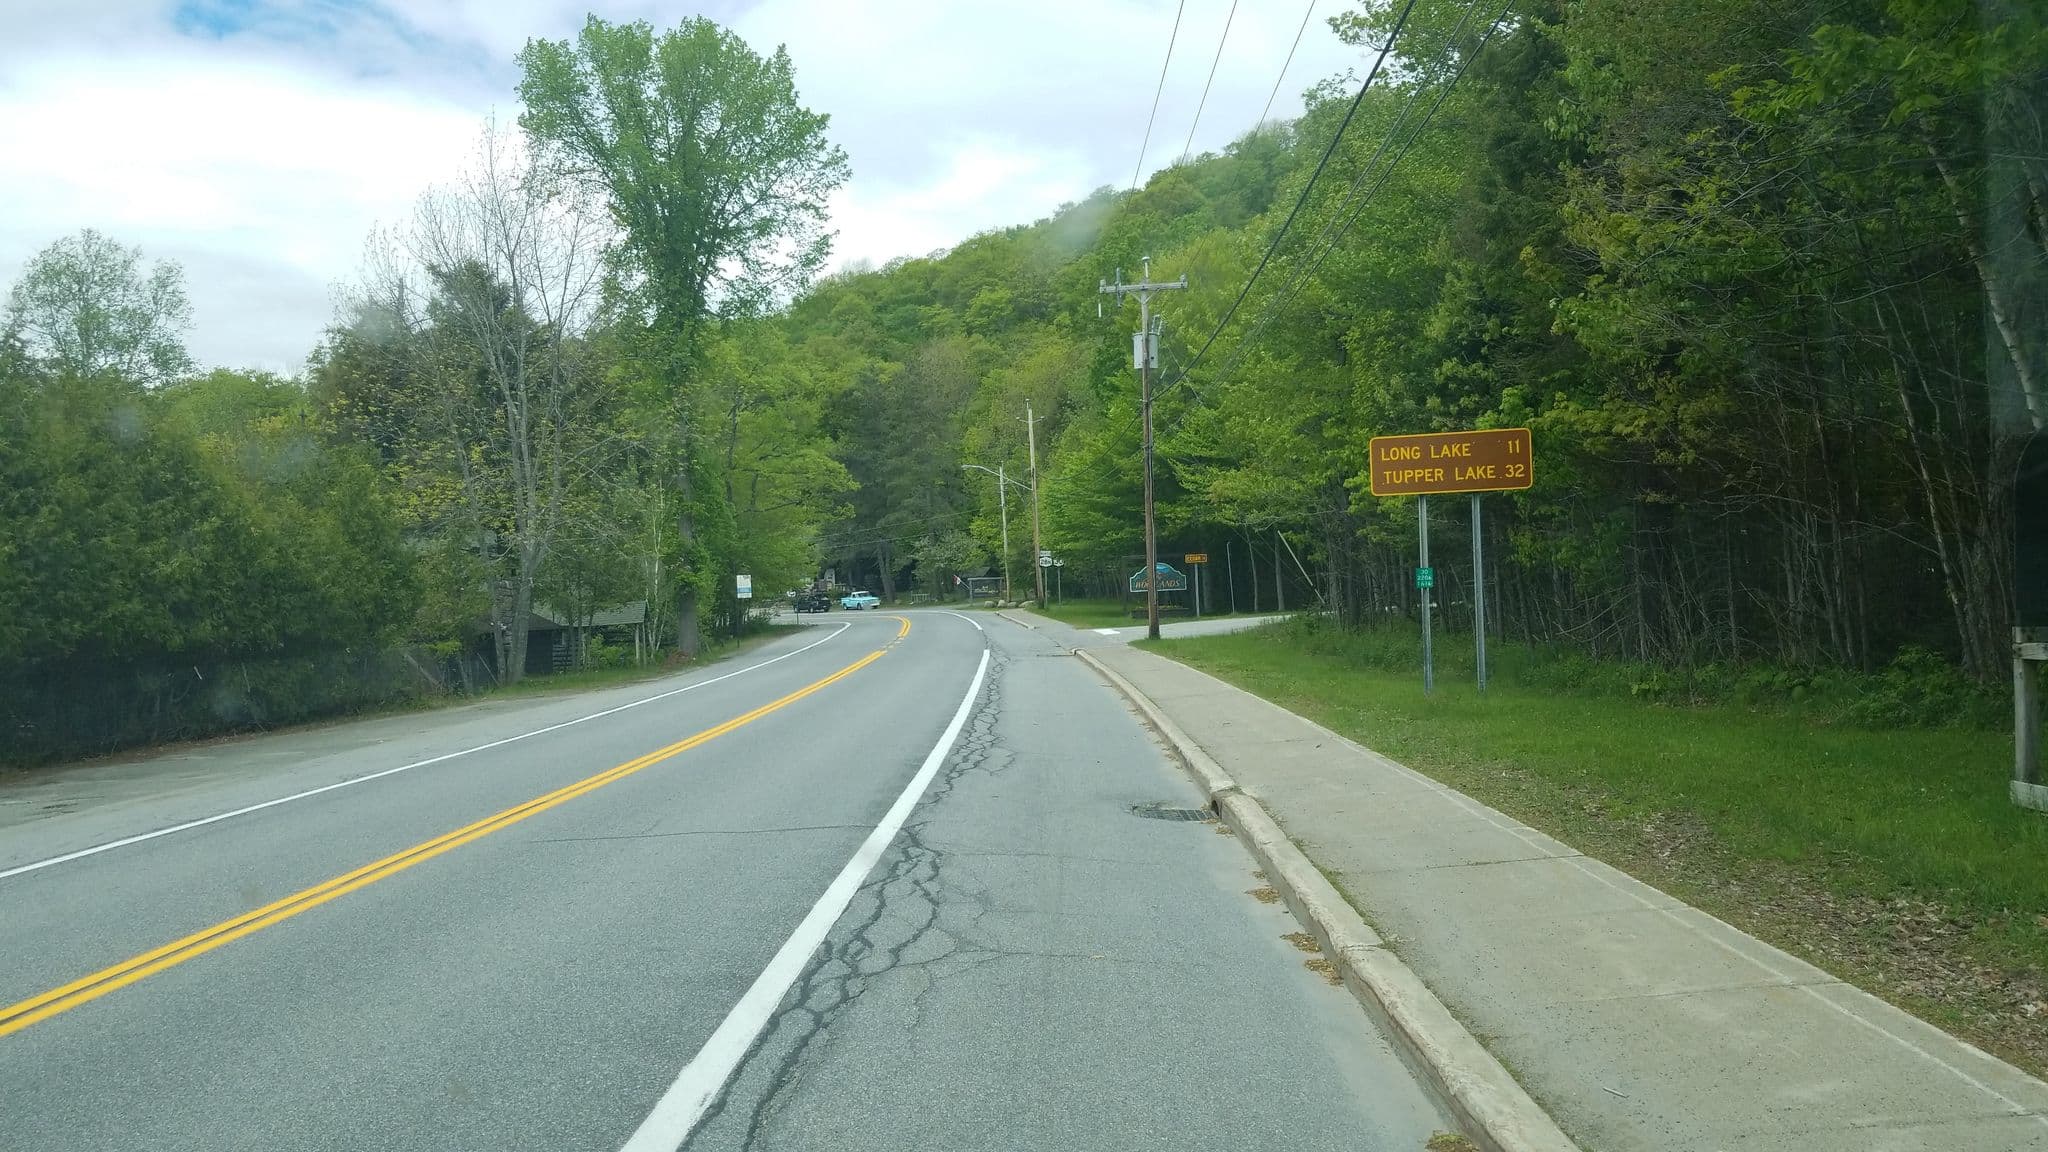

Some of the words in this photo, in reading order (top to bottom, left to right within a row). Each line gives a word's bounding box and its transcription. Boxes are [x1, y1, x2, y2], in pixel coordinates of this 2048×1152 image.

[1381, 446, 1421, 461] LONG
[1430, 443, 1472, 459] LAKE
[1507, 439, 1520, 454] 11
[1383, 468, 1444, 484] TUPPER
[1455, 465, 1496, 481] LAKE
[1505, 464, 1525, 478] 32
